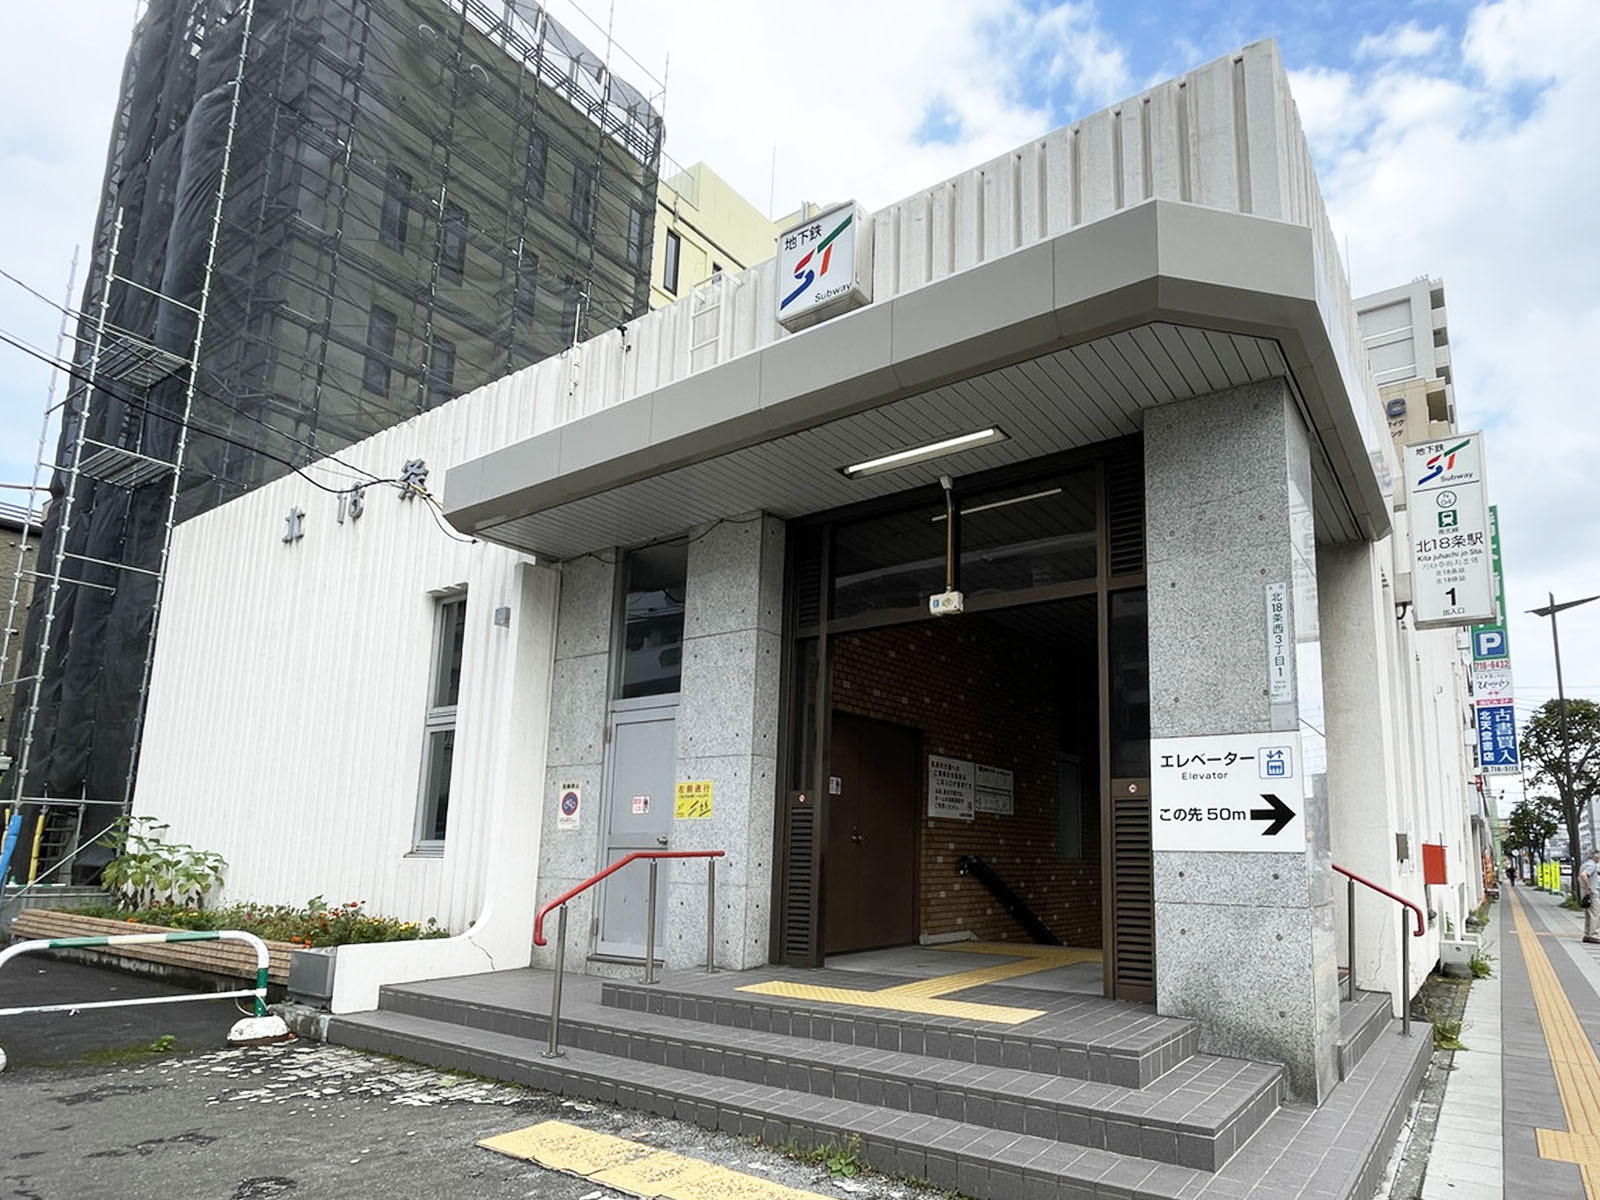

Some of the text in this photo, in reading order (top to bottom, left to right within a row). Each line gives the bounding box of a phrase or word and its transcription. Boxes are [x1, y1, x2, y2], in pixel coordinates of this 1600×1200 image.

[784, 224, 822, 251] 地下鉄
[815, 282, 852, 303] Subway
[1416, 444, 1444, 456] 地下鉄
[1441, 472, 1473, 482] Subway
[1416, 531, 1484, 553] 北18条駅
[1445, 587, 1457, 606] 1
[1442, 607, 1466, 616] 出入口
[1479, 632, 1502, 656] P
[1494, 708, 1516, 764] 古書買入
[1160, 751, 1255, 768] エレベーター
[1181, 772, 1228, 780] Elevator
[1159, 807, 1247, 822] この先 50m
